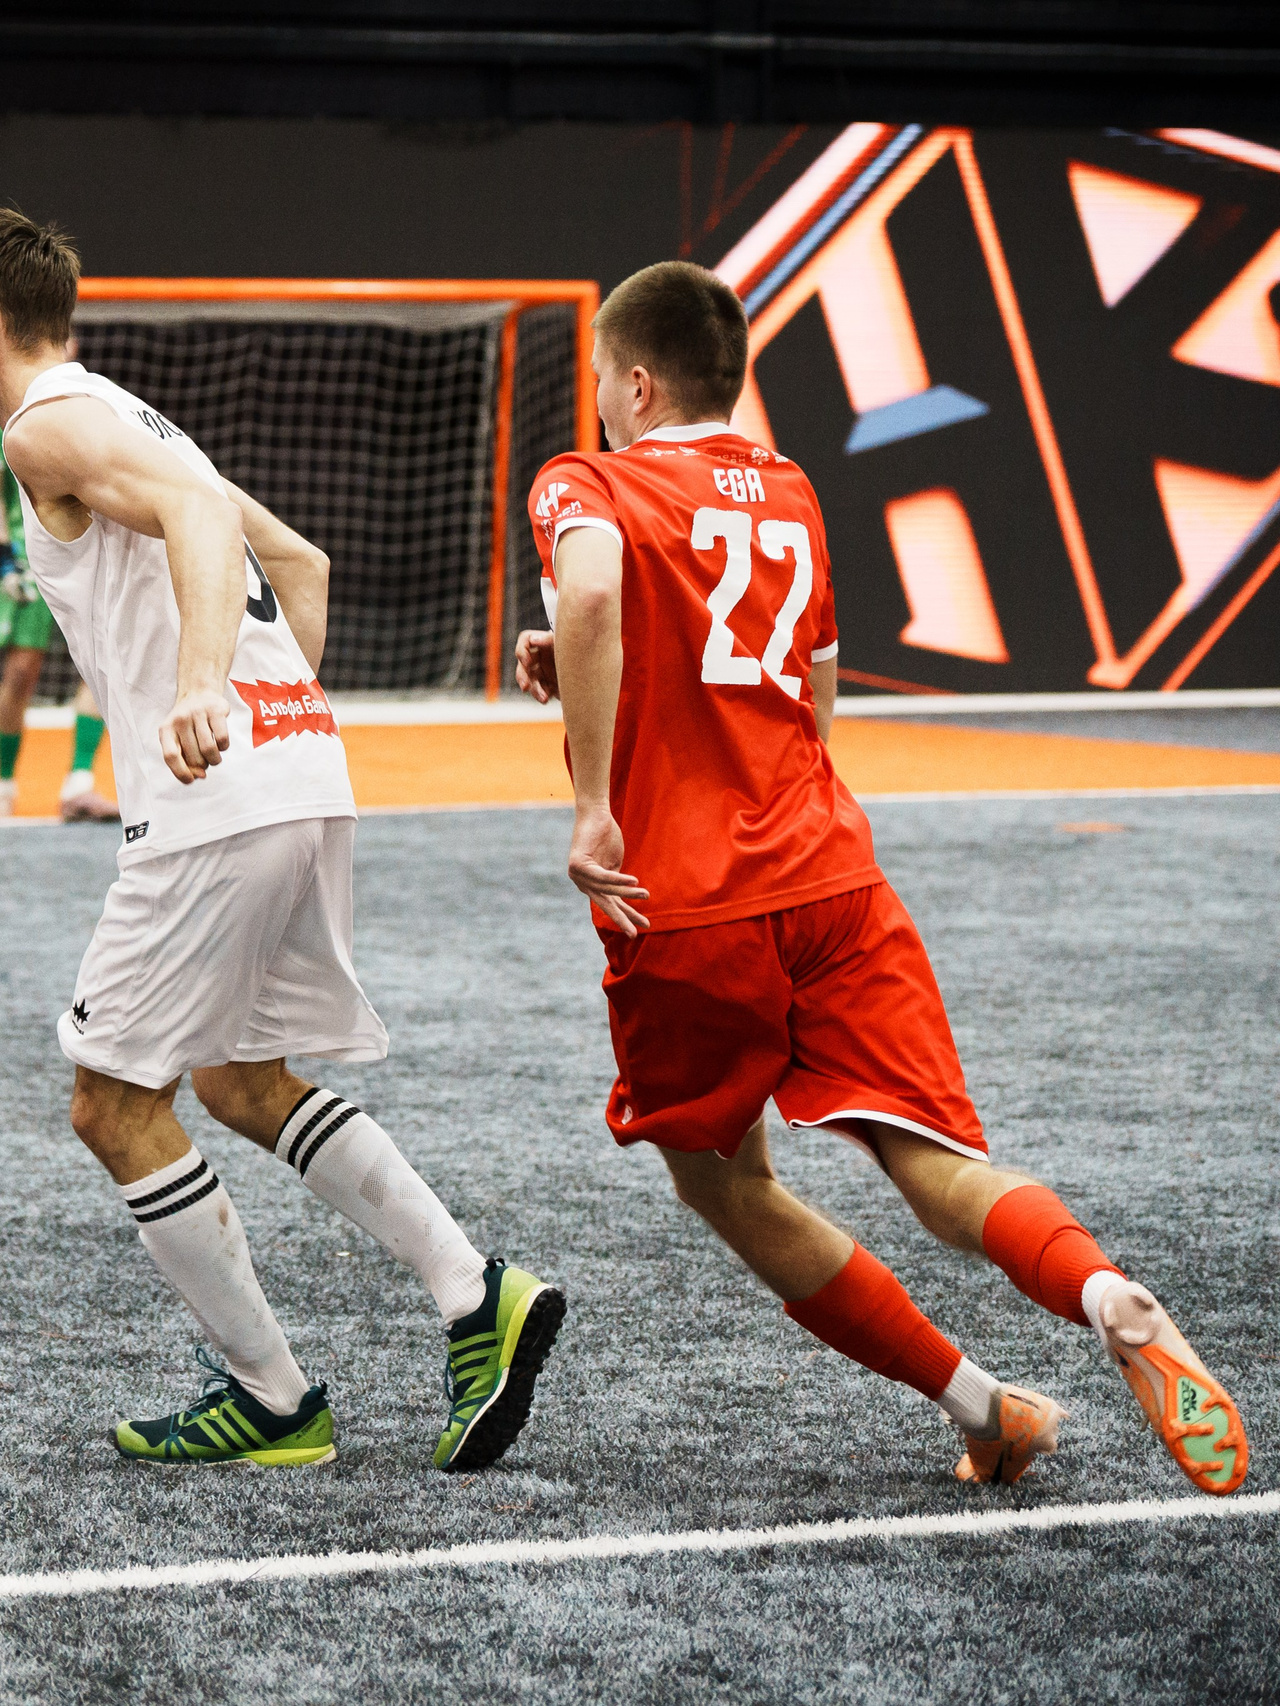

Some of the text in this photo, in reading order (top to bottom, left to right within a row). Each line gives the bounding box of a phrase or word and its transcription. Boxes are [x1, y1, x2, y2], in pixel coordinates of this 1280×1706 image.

[713, 468, 766, 502] EGA
[690, 506, 813, 701] 22
[258, 696, 305, 723] Альфа
